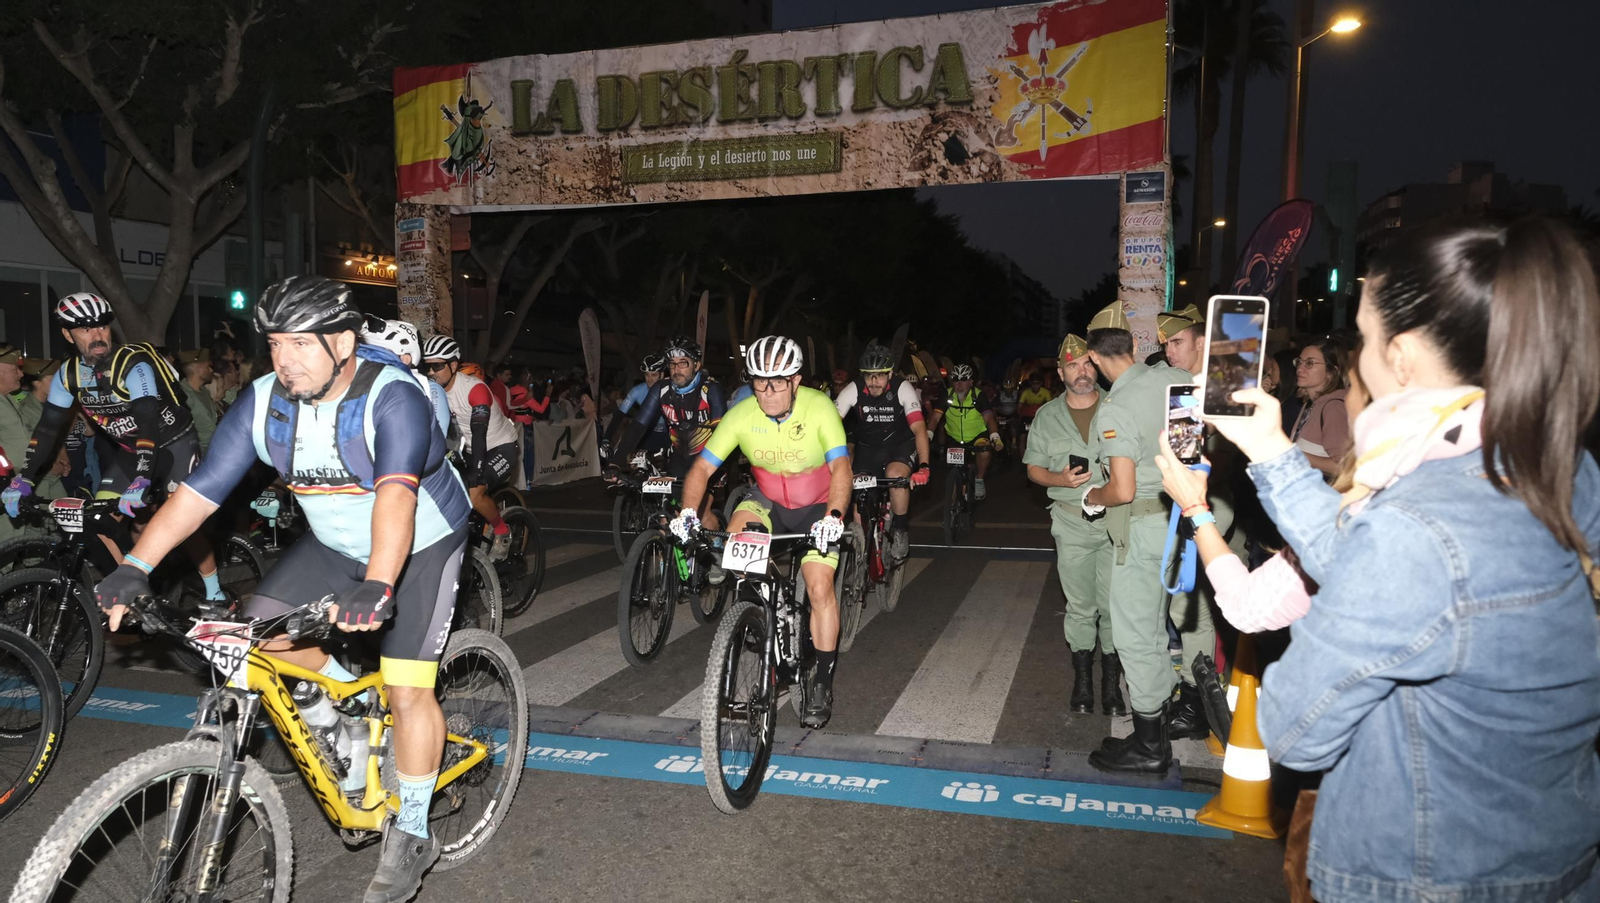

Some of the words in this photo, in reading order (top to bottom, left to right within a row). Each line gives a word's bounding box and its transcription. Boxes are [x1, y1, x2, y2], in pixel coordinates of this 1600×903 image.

[510, 79, 584, 134] LA
[596, 42, 974, 132] DESÉRTICA
[642, 155, 654, 169] La
[658, 152, 693, 170] Legión
[698, 155, 705, 169] y
[710, 151, 720, 166] el
[725, 148, 767, 164] desierto
[772, 148, 791, 162] nos
[797, 147, 817, 161] une
[1125, 244, 1162, 255] RENTA
[398, 323, 418, 341] POC
[539, 465, 556, 475] Junta
[557, 464, 565, 472] de
[565, 458, 589, 471] Andalucía
[731, 541, 765, 561] 6371
[28, 732, 56, 784] MAXXIS
[552, 757, 592, 767] RURAL
[794, 781, 829, 790] CAJA
[832, 784, 879, 795] RURAL
[1106, 811, 1147, 822] CAJA
